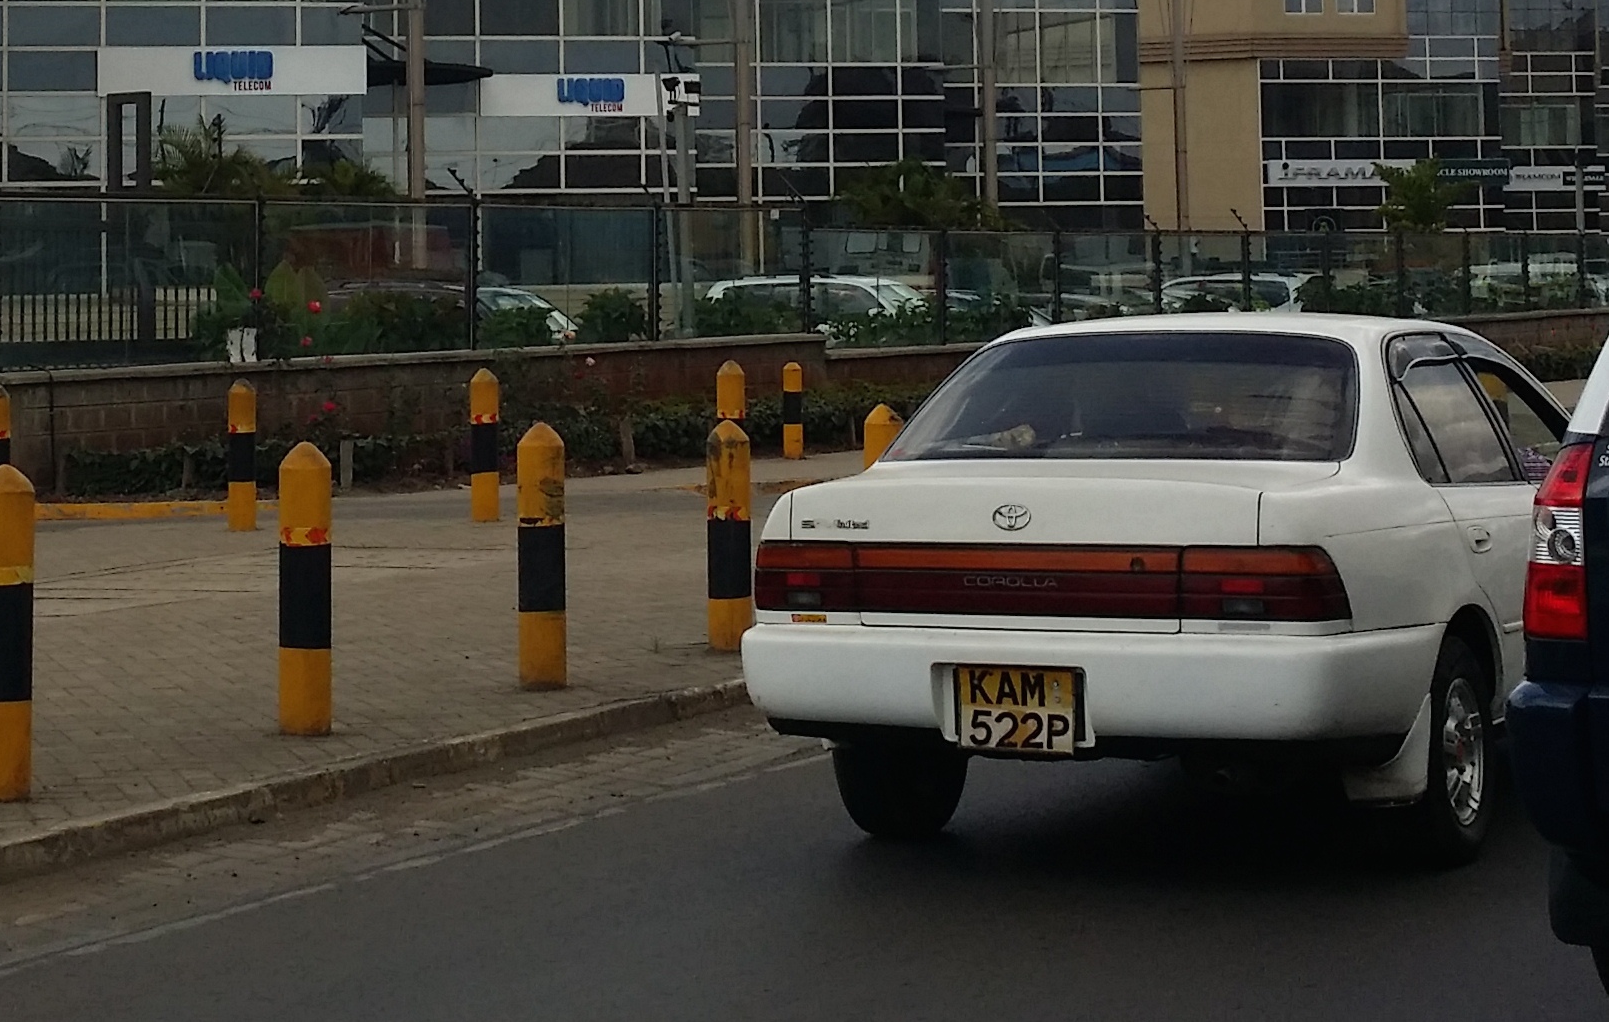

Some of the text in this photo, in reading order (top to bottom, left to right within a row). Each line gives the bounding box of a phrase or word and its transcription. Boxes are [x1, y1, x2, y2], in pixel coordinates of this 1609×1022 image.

[233, 80, 272, 91] TELECOM
[591, 102, 623, 113] TELECOM
[1457, 168, 1508, 177] SHOWROOM
[963, 575, 1058, 588] COROLLA
[970, 669, 1047, 708] KAM
[968, 709, 1071, 749] 522P
